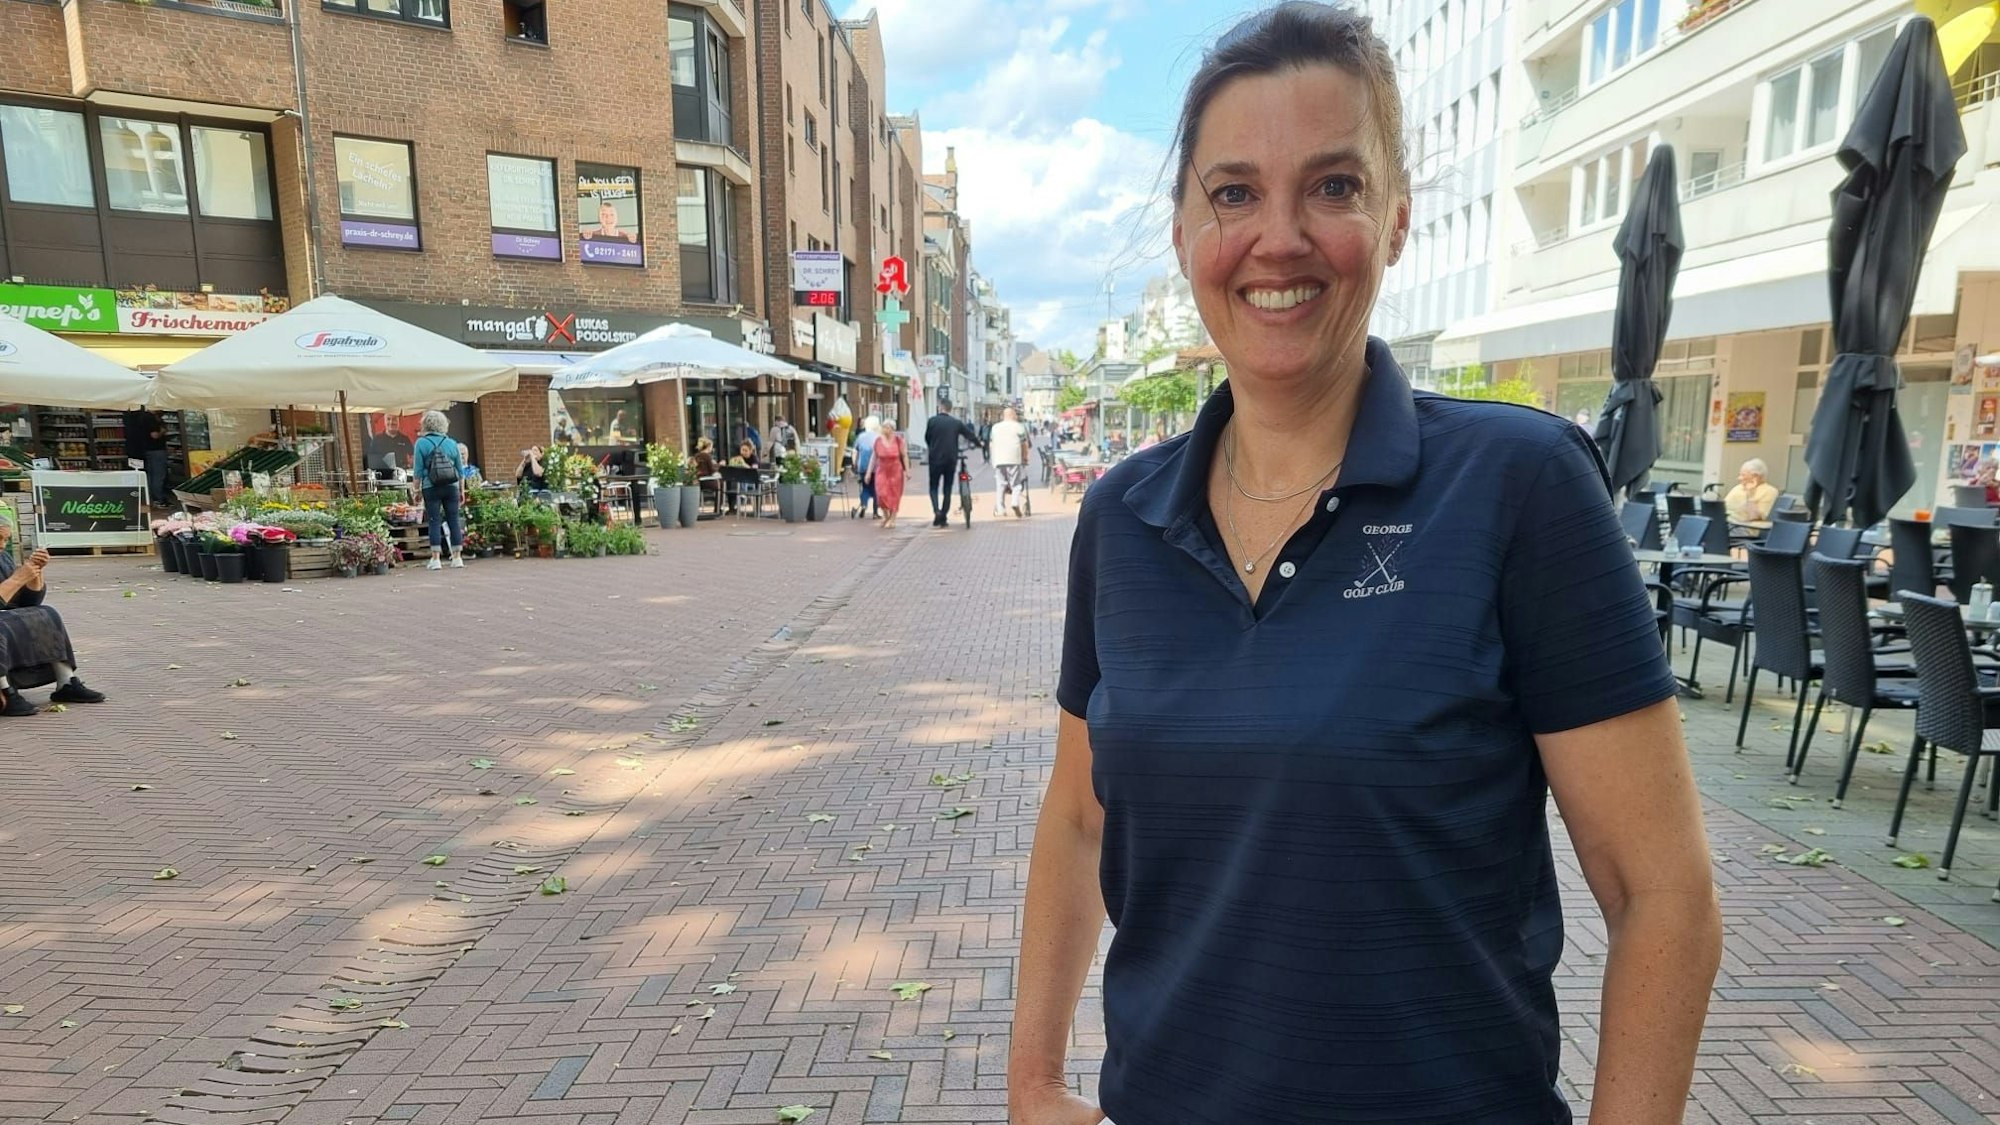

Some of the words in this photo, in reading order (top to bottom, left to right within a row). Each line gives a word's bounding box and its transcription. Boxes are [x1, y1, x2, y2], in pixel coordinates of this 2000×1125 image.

[345, 227, 414, 241] praxis-dr-schrey.de
[131, 311, 267, 331] Frischemar
[467, 316, 536, 341] mangal
[575, 318, 609, 330] LUKAS
[305, 333, 379, 348] Segafredo
[61, 500, 125, 515] Nassiri
[1362, 524, 1413, 535] GEORGE
[1343, 586, 1375, 599] GOLF
[1375, 580, 1405, 595] CLUB
